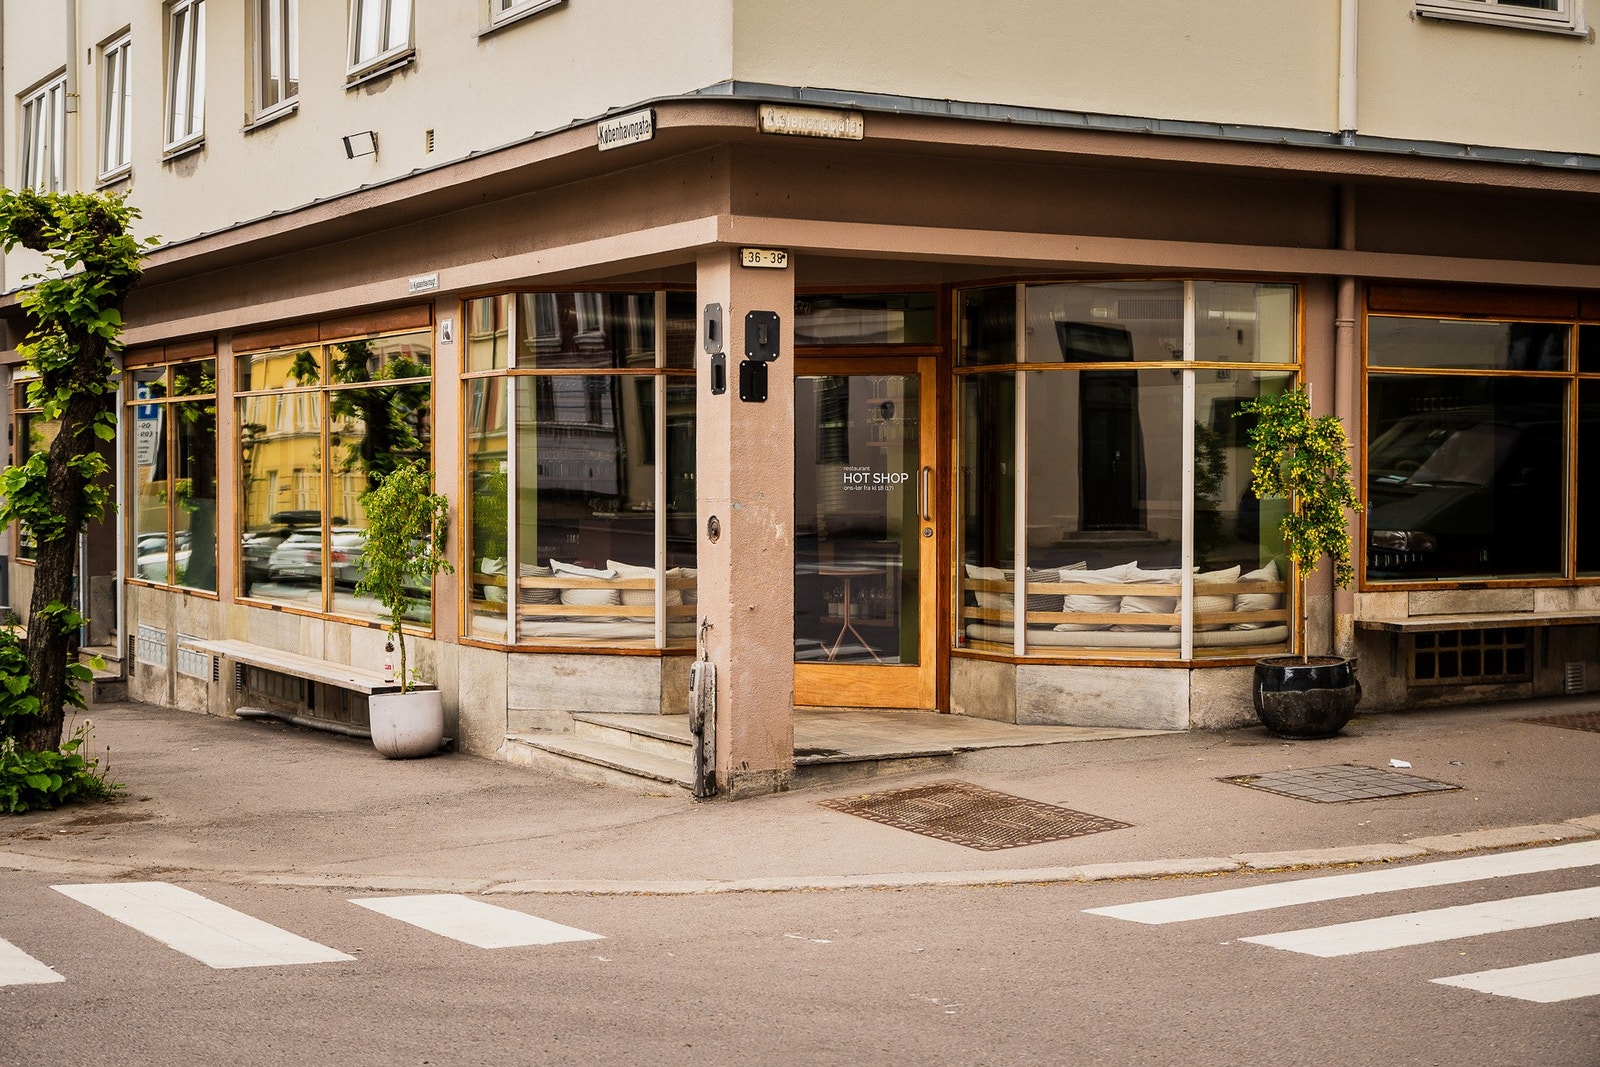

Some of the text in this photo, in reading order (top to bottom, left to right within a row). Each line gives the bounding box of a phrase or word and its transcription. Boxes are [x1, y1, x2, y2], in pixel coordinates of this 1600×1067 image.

[748, 251, 761, 263] 36
[770, 252, 783, 264] 38
[843, 472, 909, 484] HOT SHOP
